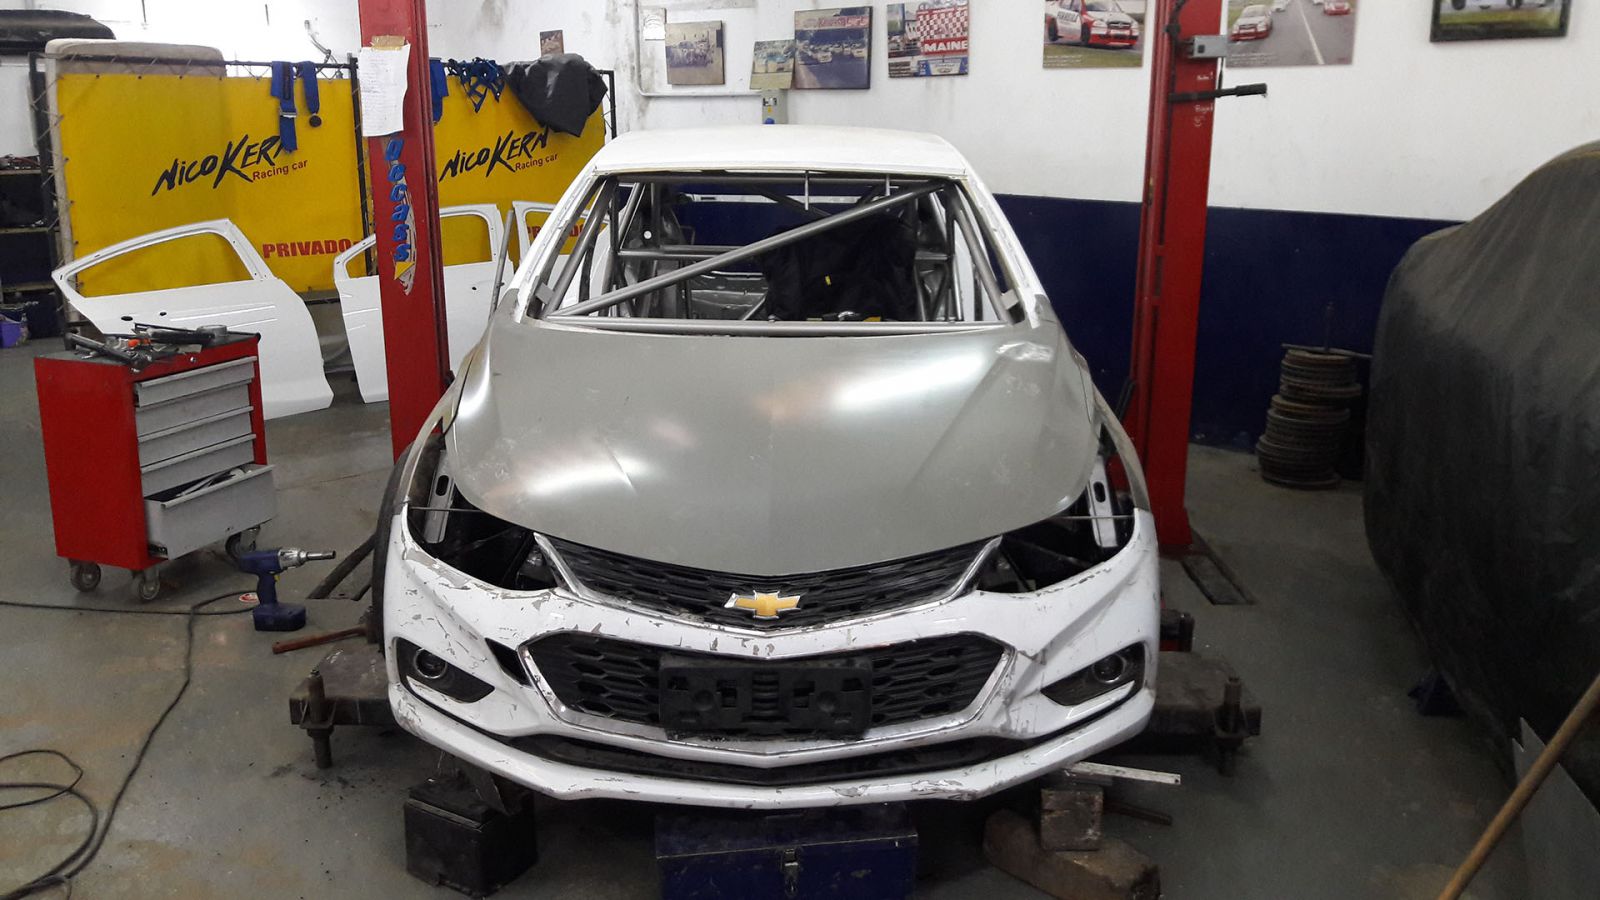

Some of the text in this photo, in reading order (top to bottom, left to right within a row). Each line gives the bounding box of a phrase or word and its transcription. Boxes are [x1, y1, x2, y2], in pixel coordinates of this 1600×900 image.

[924, 41, 968, 53] MAINE
[252, 159, 308, 181] Racing car
[515, 152, 558, 171] Racing car
[262, 239, 351, 259] PRIVADO
